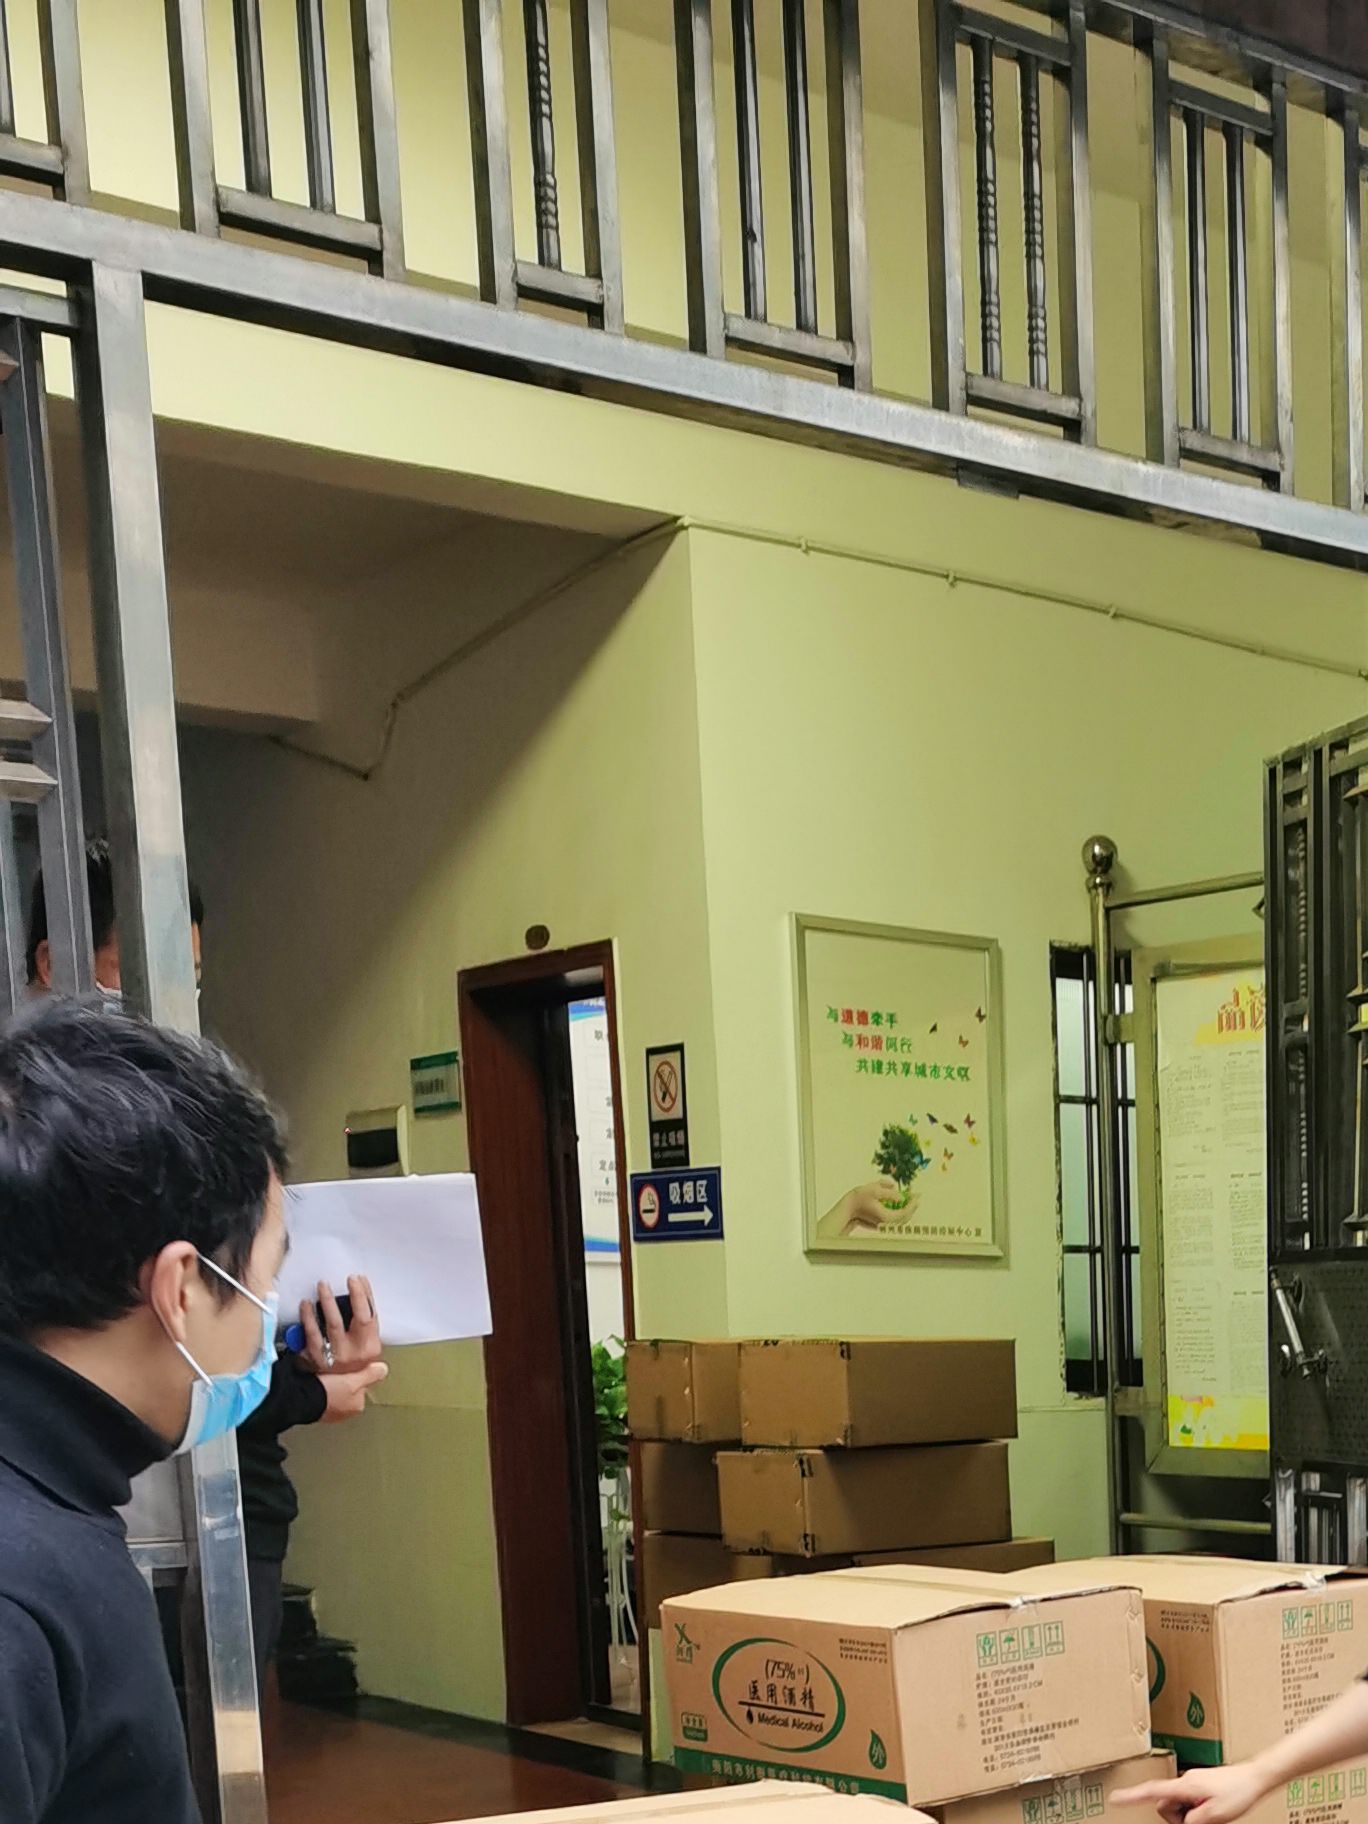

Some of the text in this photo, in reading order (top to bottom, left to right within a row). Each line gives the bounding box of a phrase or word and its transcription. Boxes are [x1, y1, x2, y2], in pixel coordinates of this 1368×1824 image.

[668, 1179, 708, 1205] 吸烟区
[757, 1711, 824, 1734] Medical Alcohol
